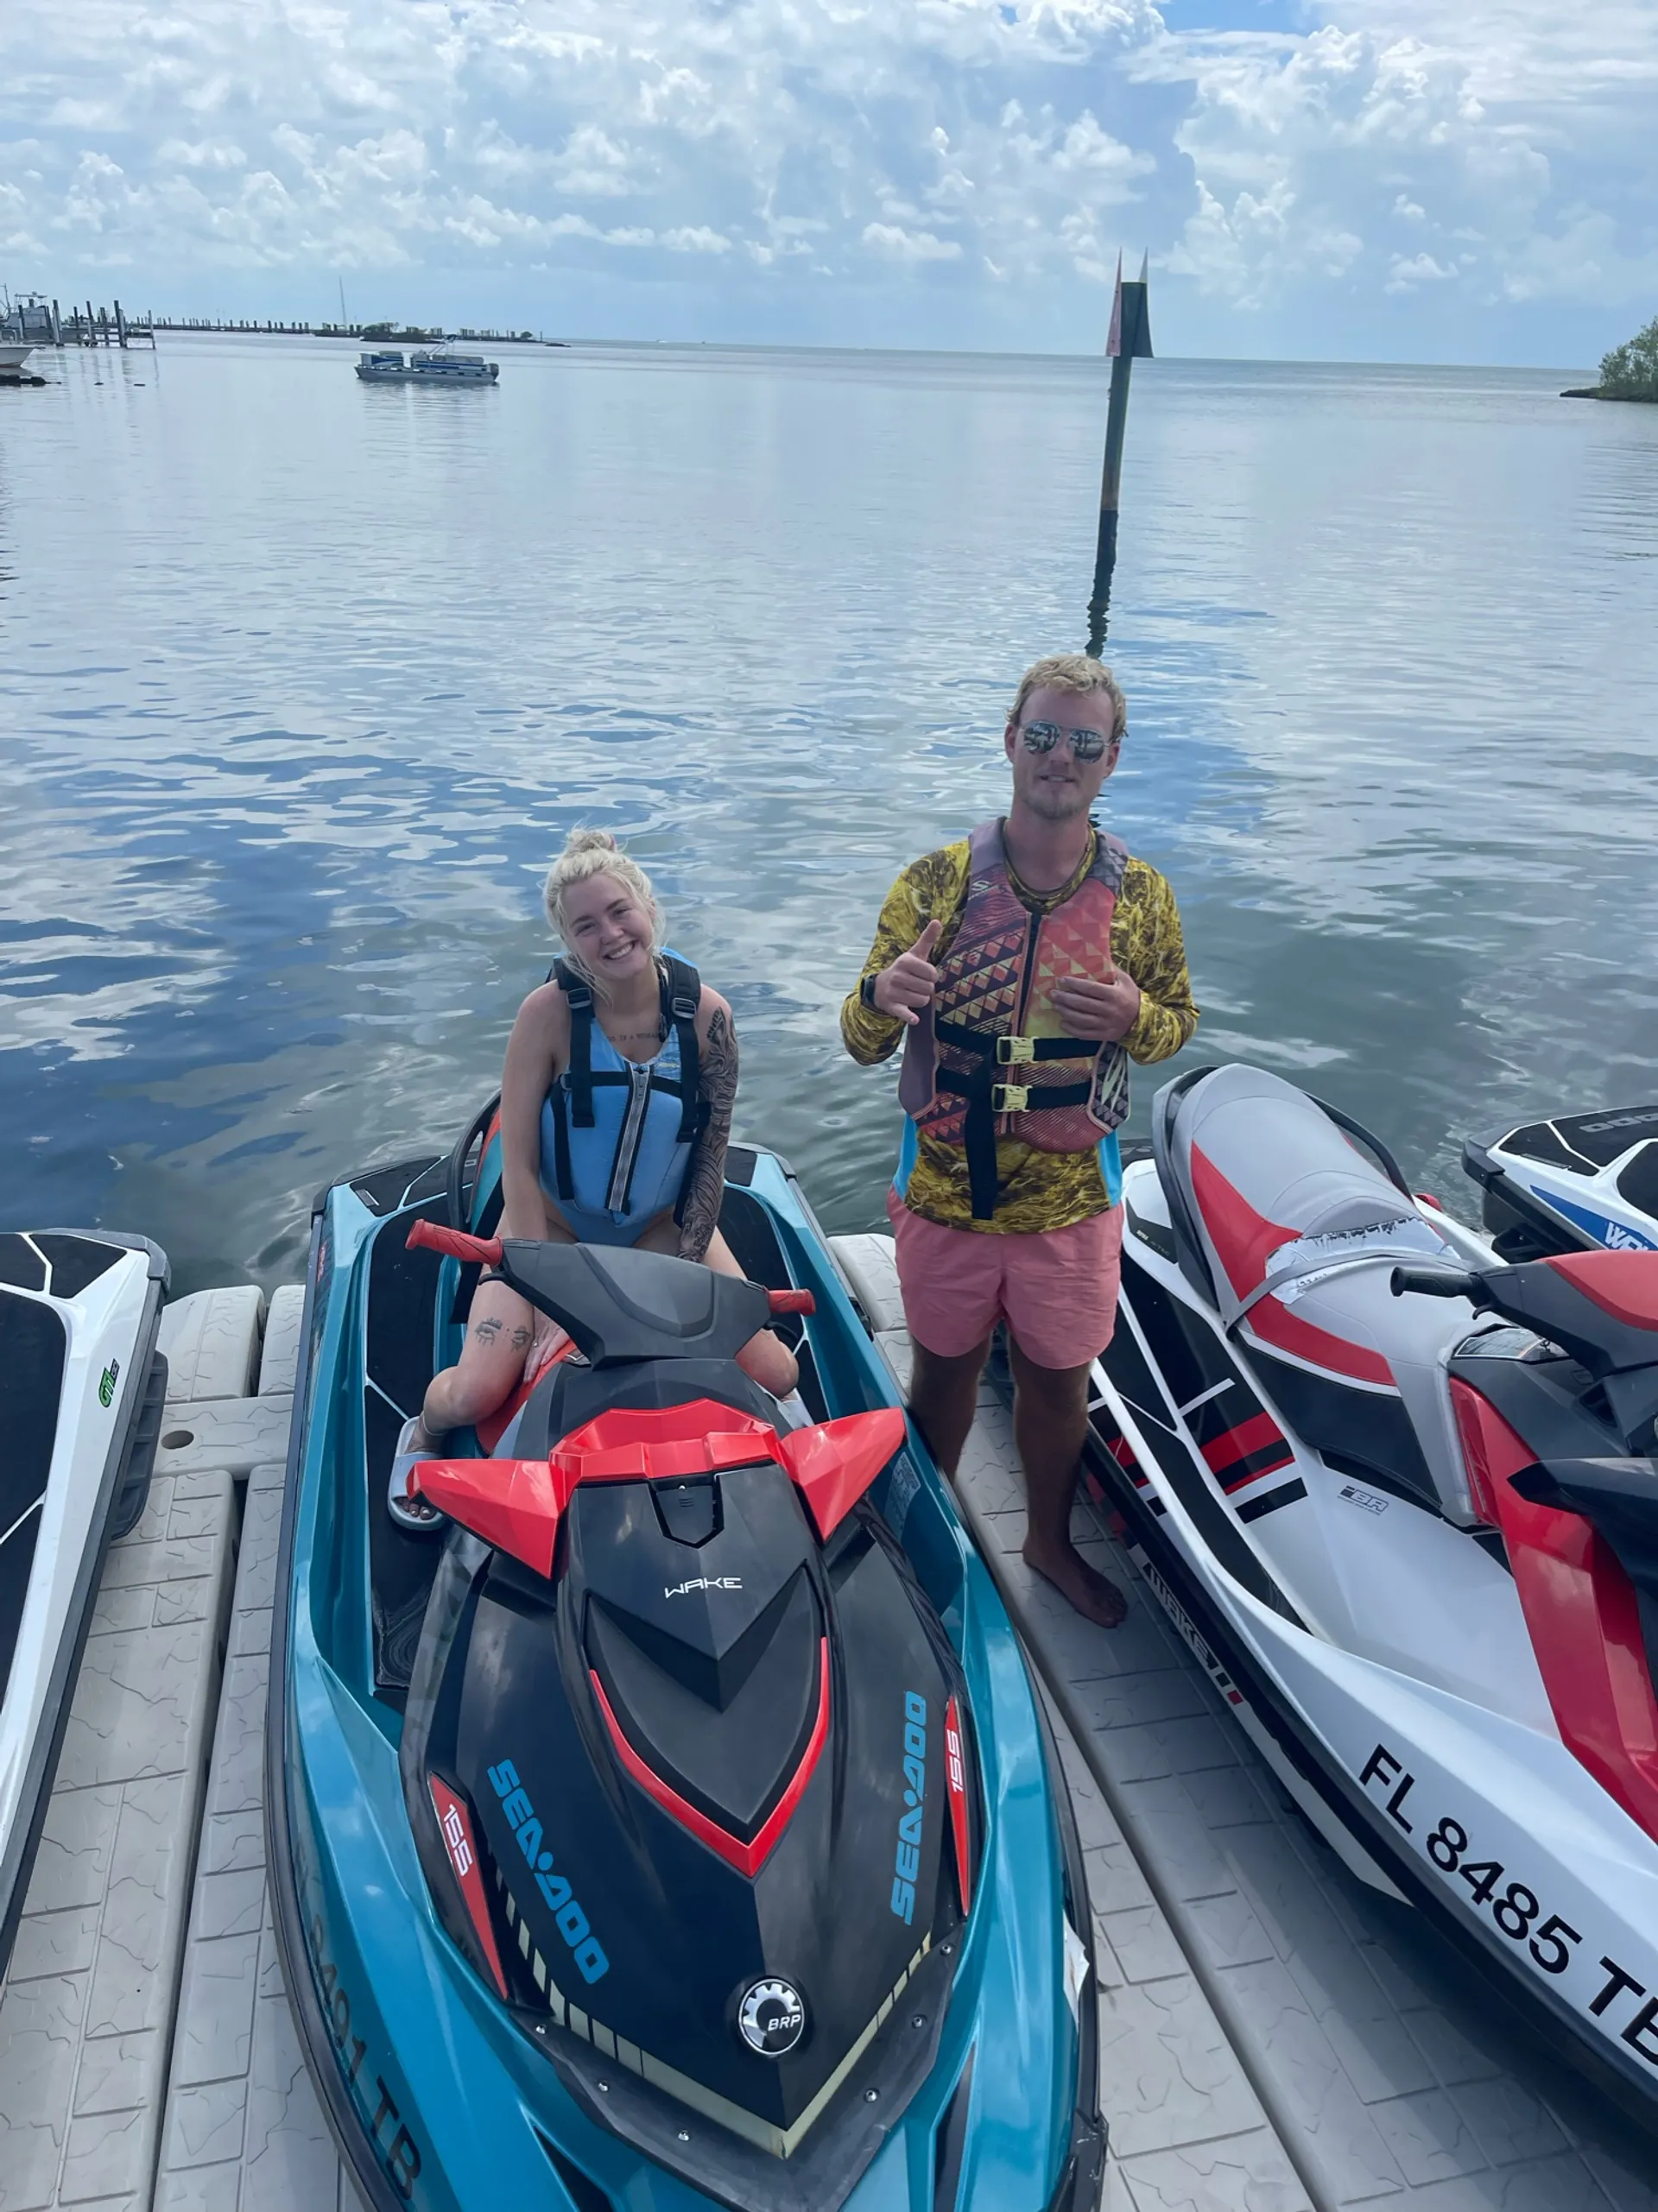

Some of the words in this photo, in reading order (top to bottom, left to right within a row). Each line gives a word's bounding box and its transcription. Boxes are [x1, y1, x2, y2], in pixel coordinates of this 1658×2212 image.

[665, 1577, 743, 1598] WAKE
[946, 1729, 964, 1792] 155
[443, 1804, 472, 1876] 155
[1359, 1743, 1415, 1835] FL
[1426, 1817, 1583, 1975] 8485
[768, 2014, 801, 2032] BRP
